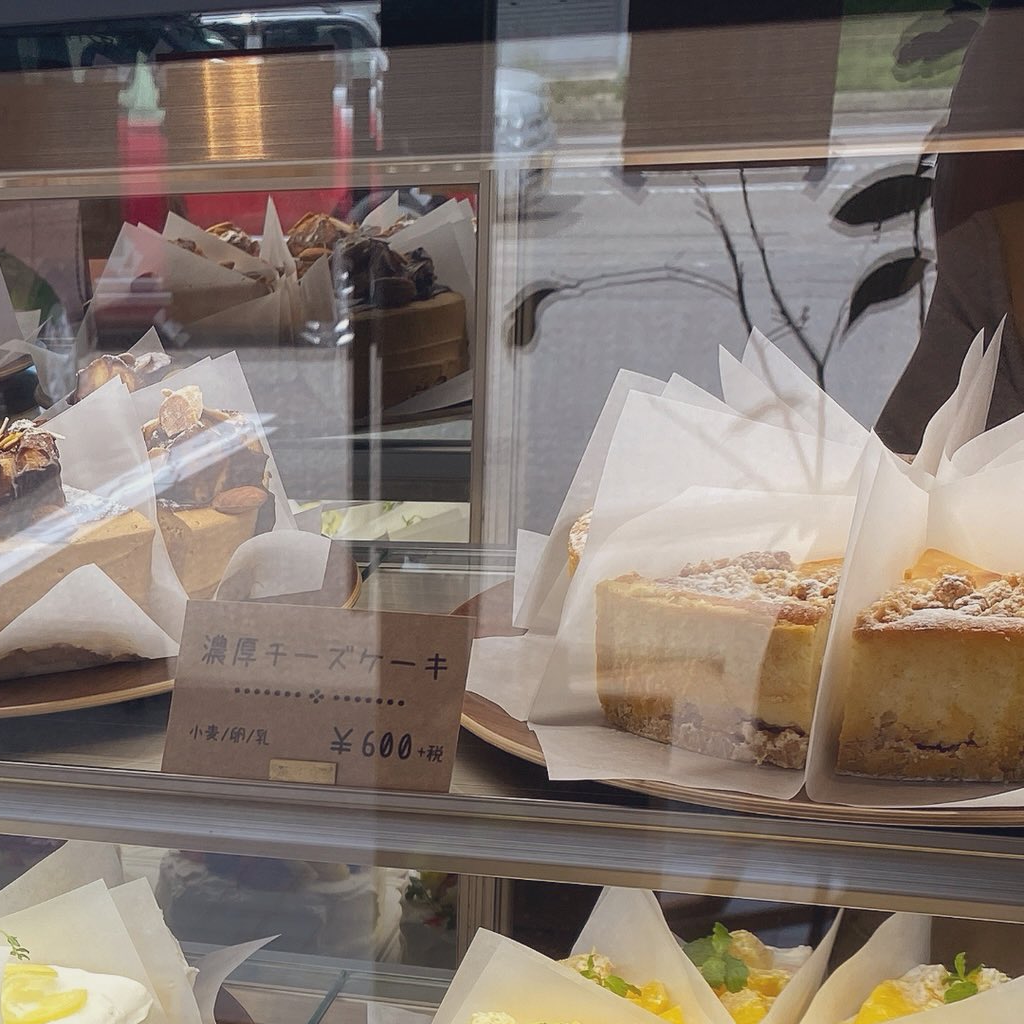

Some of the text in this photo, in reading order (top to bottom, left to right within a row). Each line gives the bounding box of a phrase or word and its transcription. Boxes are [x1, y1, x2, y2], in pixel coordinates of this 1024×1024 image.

[202, 635, 448, 680] 濃厚チーズケーキ
[189, 724, 270, 746] 小麦/卵/乳
